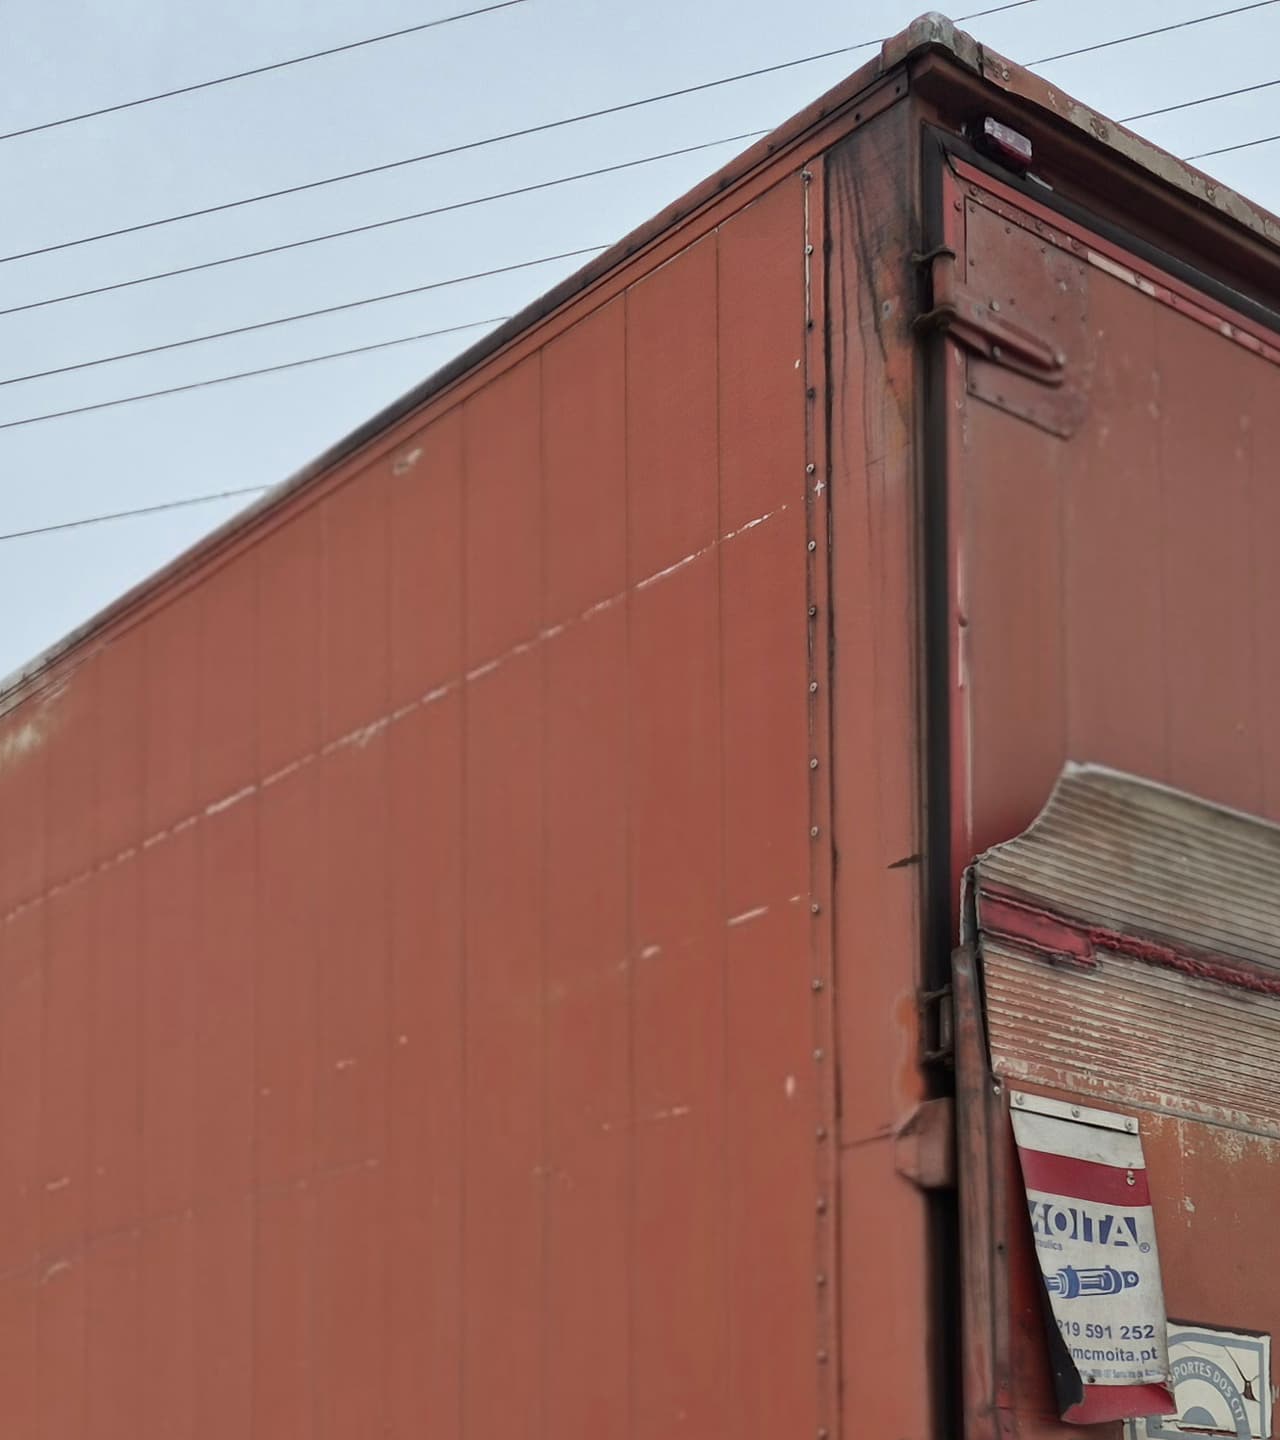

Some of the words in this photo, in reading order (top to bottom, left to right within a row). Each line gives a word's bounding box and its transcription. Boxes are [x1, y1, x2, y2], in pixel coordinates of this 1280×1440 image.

[1085, 1324, 1113, 1340] 591
[1120, 1325, 1156, 1340] 252
[1068, 1344, 1158, 1364] mcmoita.pt
[1172, 1361, 1212, 1379] PORTES
[1213, 1371, 1232, 1397] DOS
[1231, 1398, 1246, 1422] CTT
